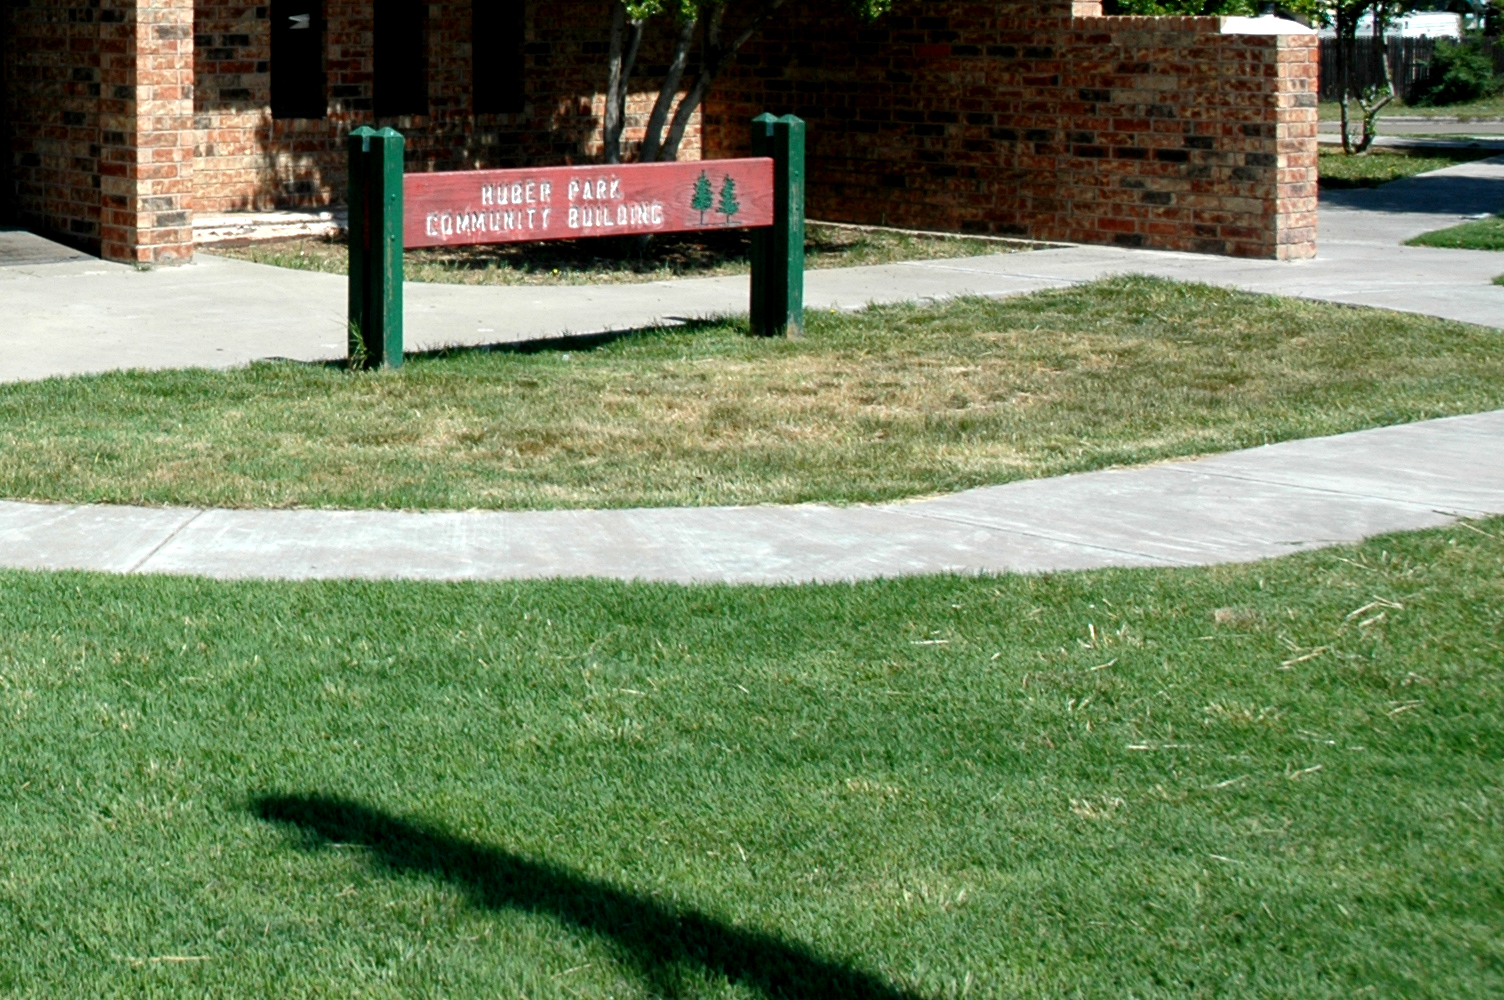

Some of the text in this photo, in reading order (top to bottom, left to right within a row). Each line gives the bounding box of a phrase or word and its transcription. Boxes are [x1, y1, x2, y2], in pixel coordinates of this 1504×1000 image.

[482, 178, 622, 205] HUBER PARK
[426, 202, 664, 237] COMMUNITY BUILDING
